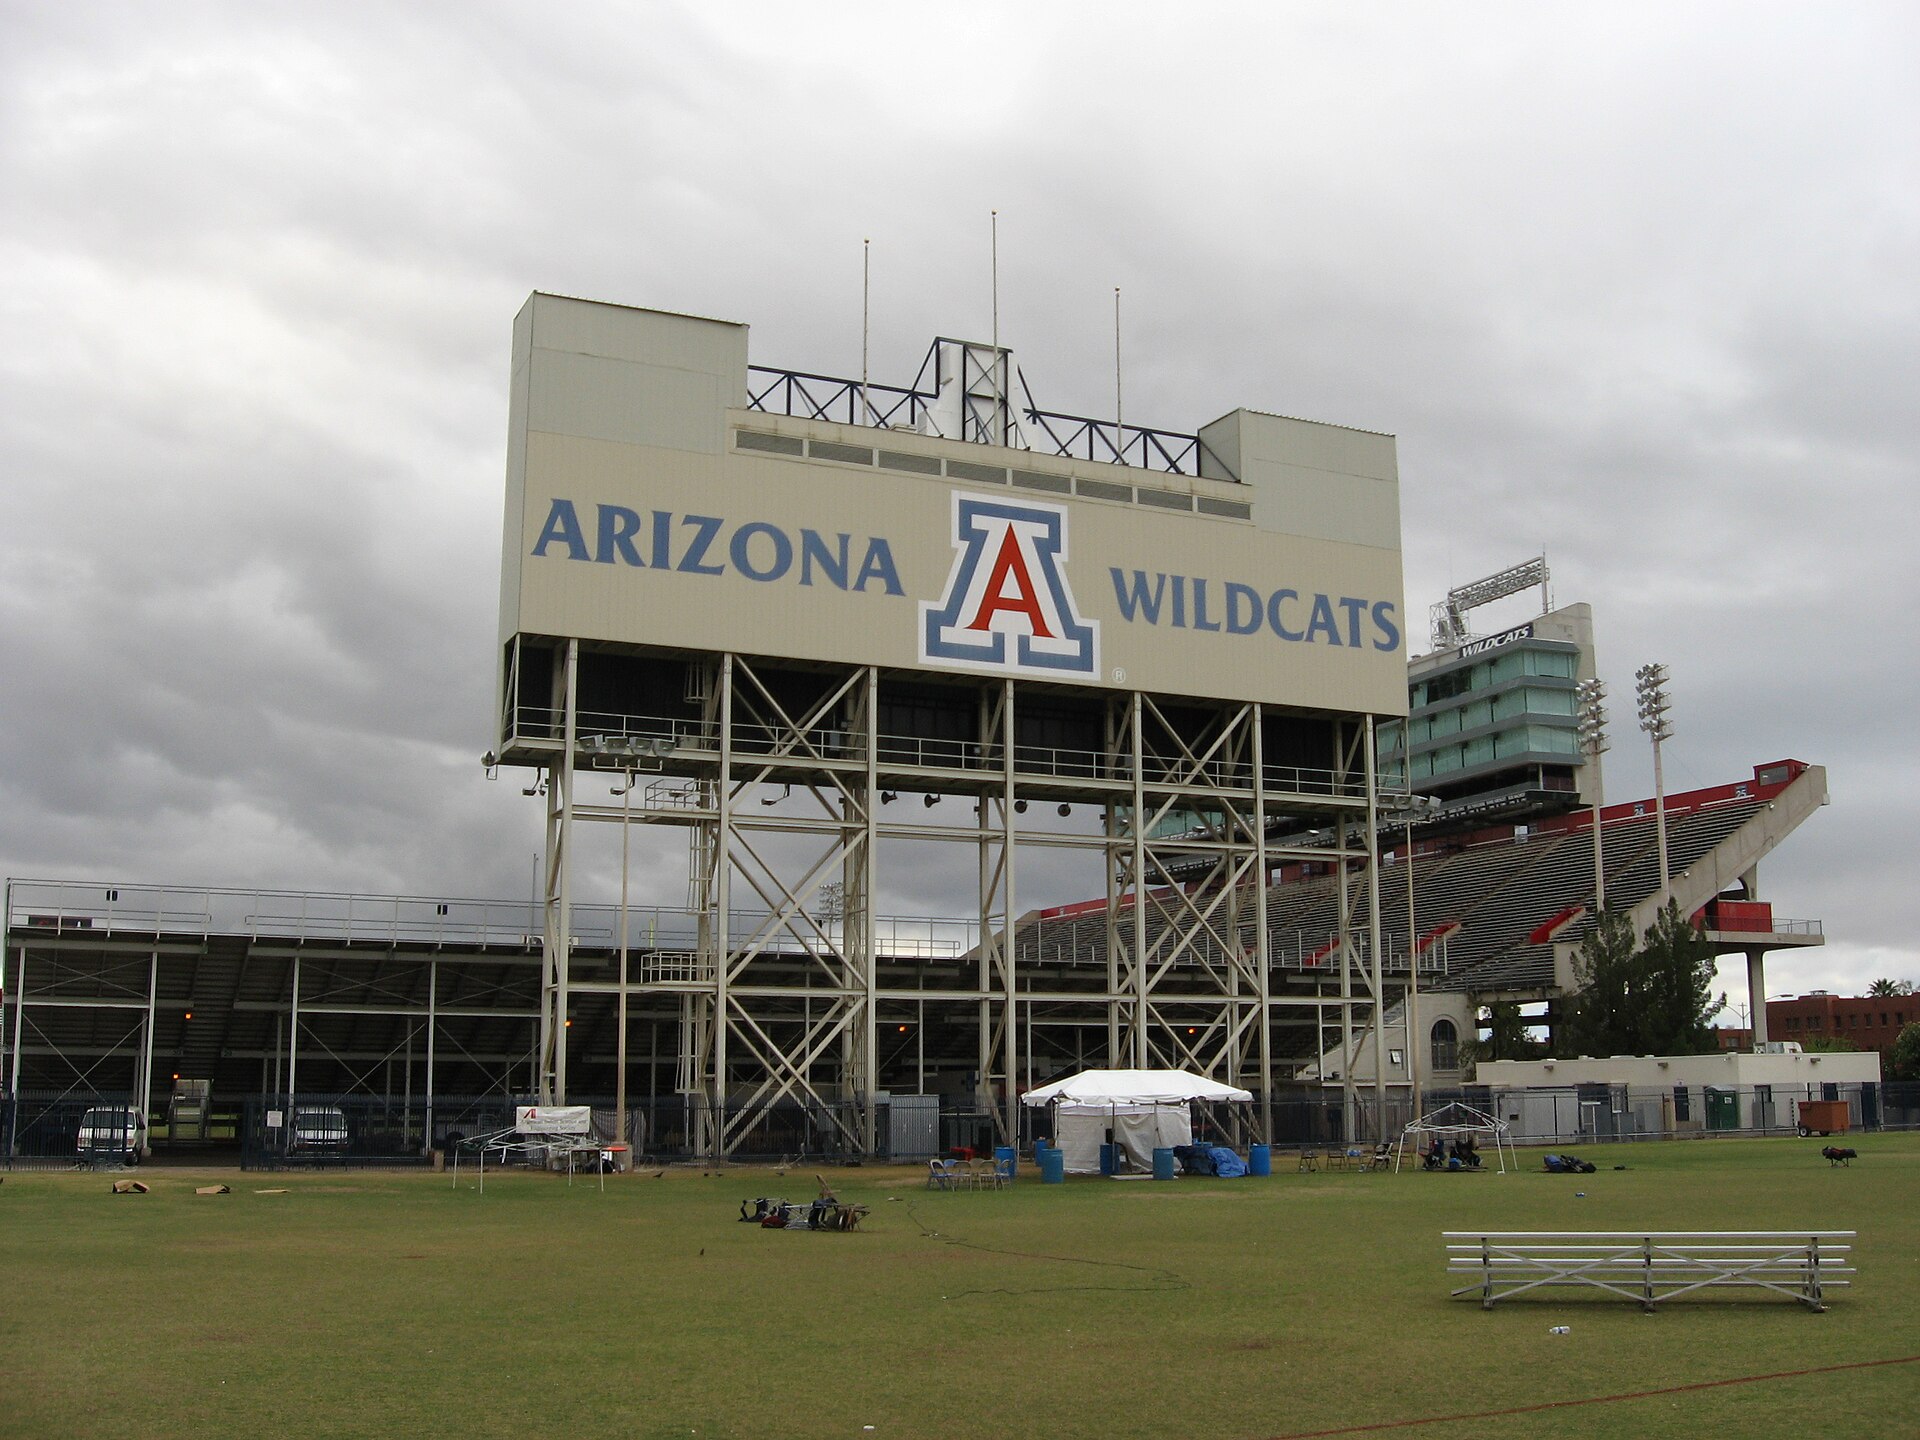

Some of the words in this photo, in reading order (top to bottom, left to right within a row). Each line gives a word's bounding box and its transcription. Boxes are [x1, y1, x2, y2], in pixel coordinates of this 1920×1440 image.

[531, 498, 906, 597] ARIZONA
[918, 490, 1101, 681] A
[1108, 567, 1401, 652] WILDCATS
[1462, 626, 1530, 658] WILDCATS
